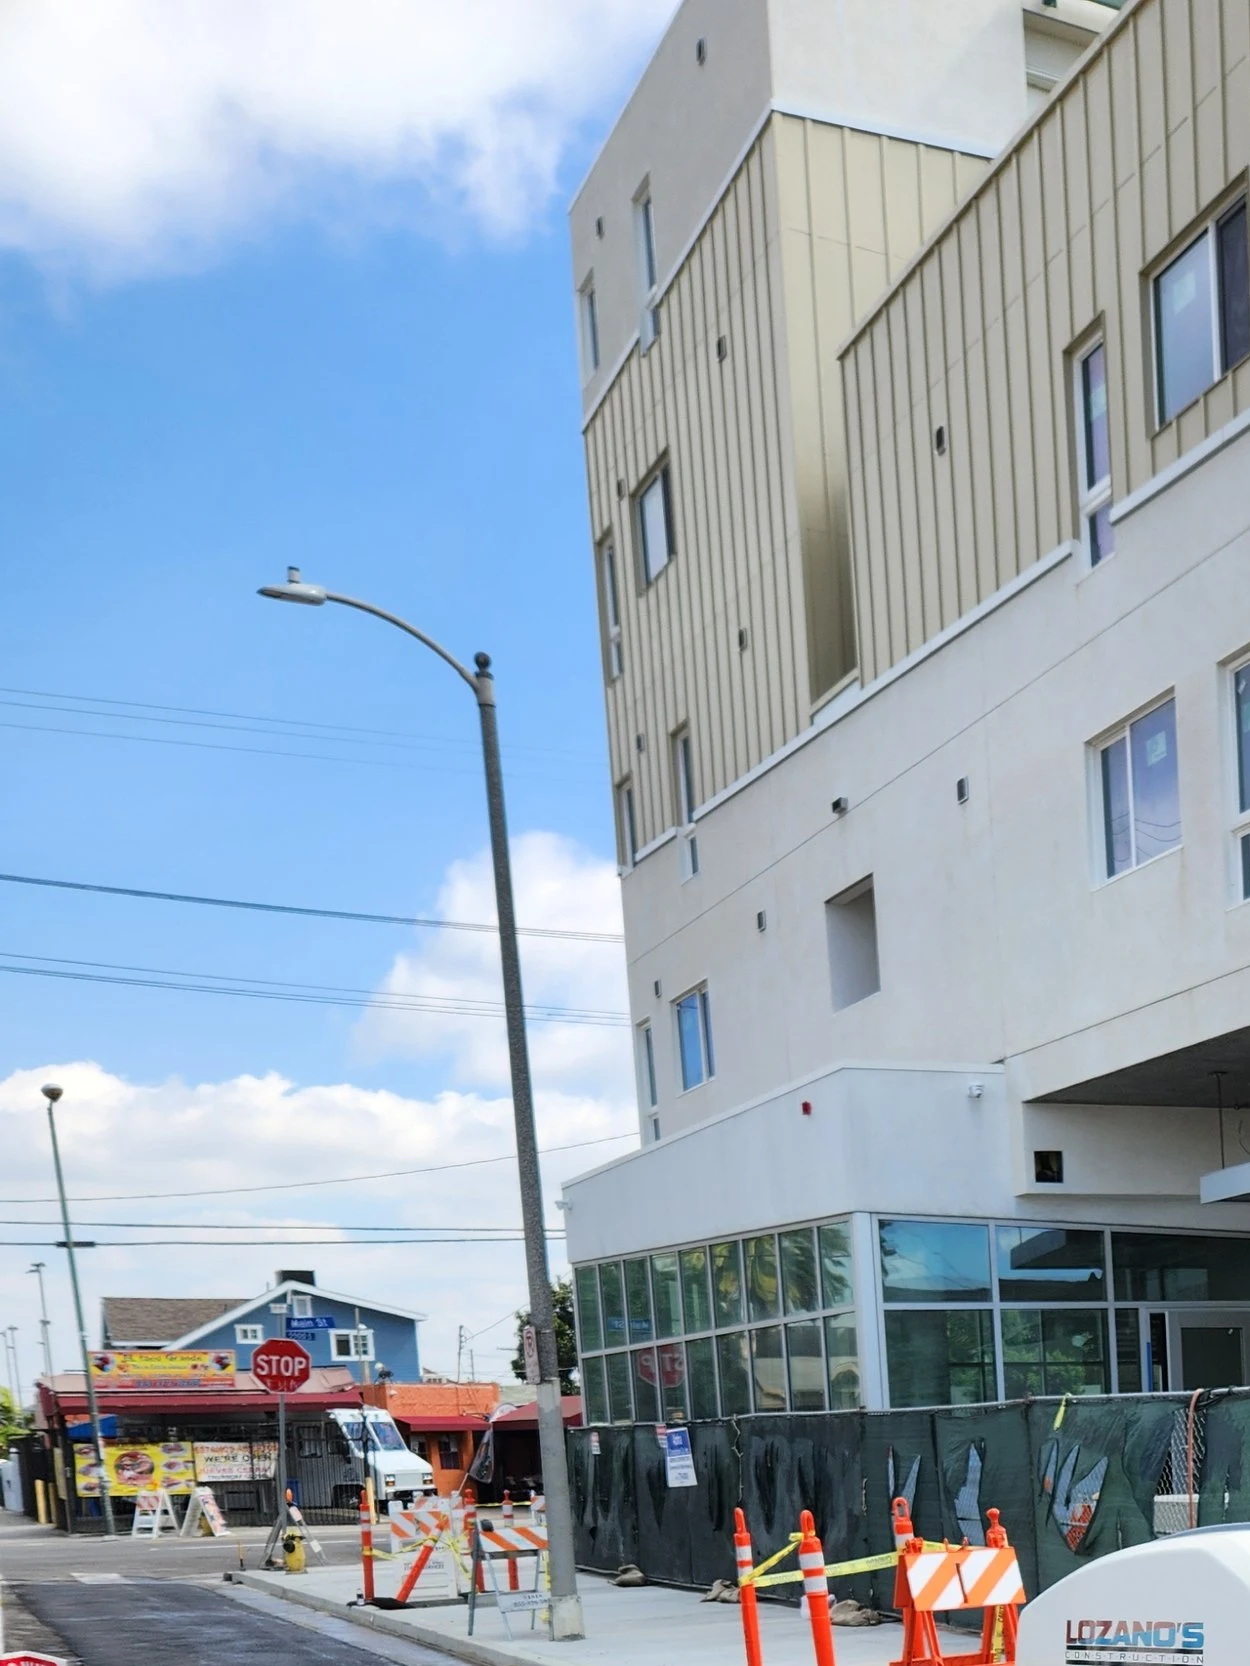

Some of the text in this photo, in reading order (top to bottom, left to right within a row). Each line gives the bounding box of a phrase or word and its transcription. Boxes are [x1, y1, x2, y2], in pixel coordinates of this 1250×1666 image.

[290, 1319, 314, 1328] Main
[256, 1355, 306, 1377] STOP
[1065, 1620, 1205, 1648] LOZANO'S
